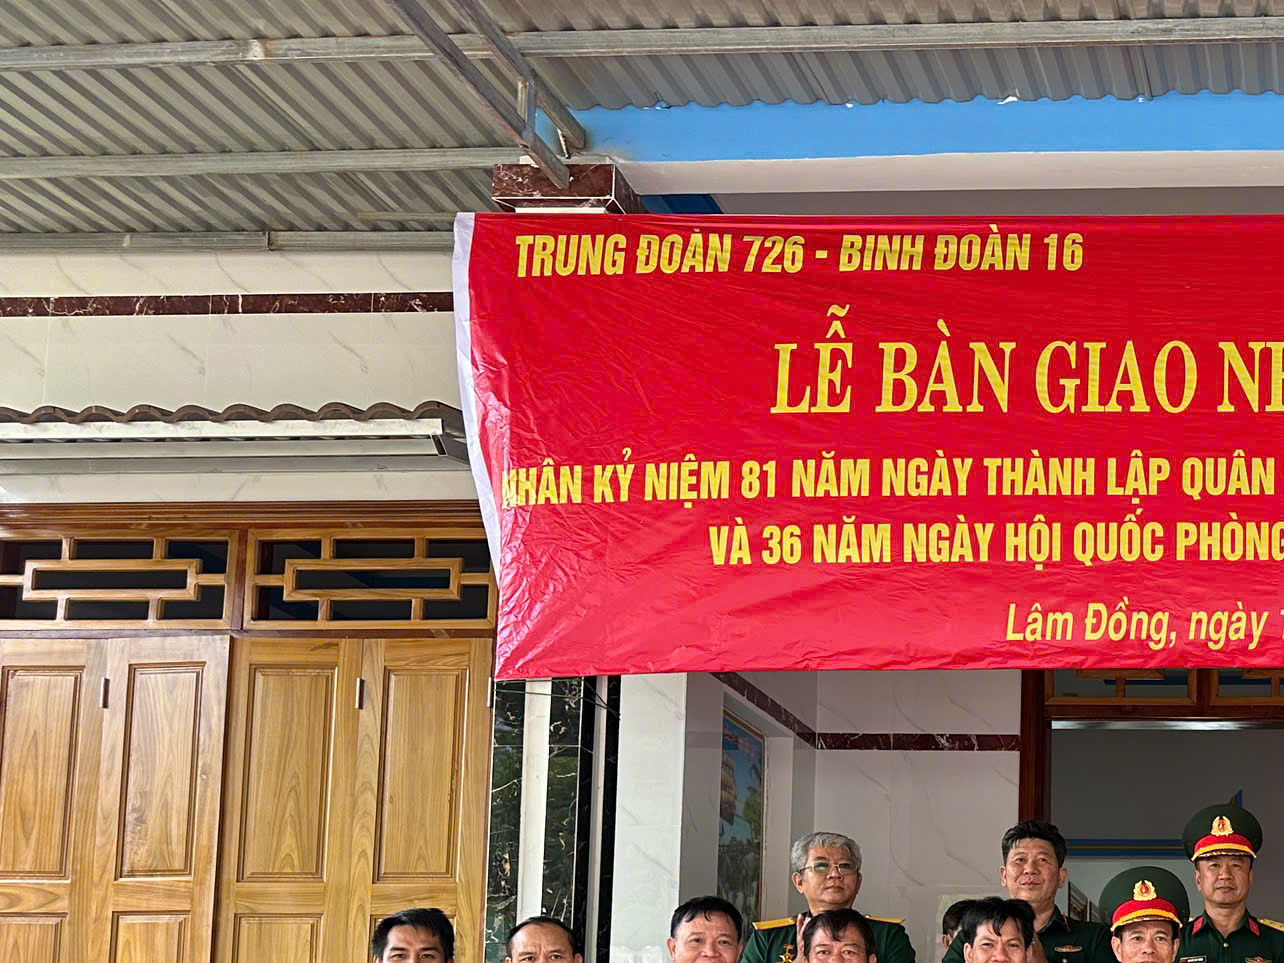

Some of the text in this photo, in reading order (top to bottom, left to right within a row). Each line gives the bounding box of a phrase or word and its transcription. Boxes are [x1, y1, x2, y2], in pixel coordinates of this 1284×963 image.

[515, 233, 626, 278] TRUNG
[635, 228, 732, 274] ĐOÀN
[743, 235, 805, 273] 726
[839, 234, 925, 272] BINH
[933, 223, 1032, 271] ĐOÀN
[1043, 232, 1084, 271] 16
[770, 304, 853, 414] LỄ
[875, 319, 1017, 413] BÀN
[1035, 340, 1198, 414] GIAO
[501, 457, 583, 508] NHÂN
[593, 447, 635, 504] KỶ
[644, 455, 730, 509] NIỆM
[740, 460, 777, 499] 81
[791, 450, 871, 497] NĂM
[881, 450, 974, 497] NGÀY
[983, 449, 1096, 496] THÀNH
[1106, 449, 1171, 505] LẬP
[1182, 449, 1275, 501] QUÂN
[708, 516, 753, 566] VÀ
[761, 524, 802, 565] 36
[813, 515, 892, 564] NĂM
[903, 514, 995, 563] NGÀY
[1005, 513, 1061, 571] HỘI
[1073, 507, 1164, 567] QUỐC
[1005, 602, 1074, 642] Lâm
[1084, 596, 1177, 651] Đồng,
[1188, 601, 1269, 651] ngày
